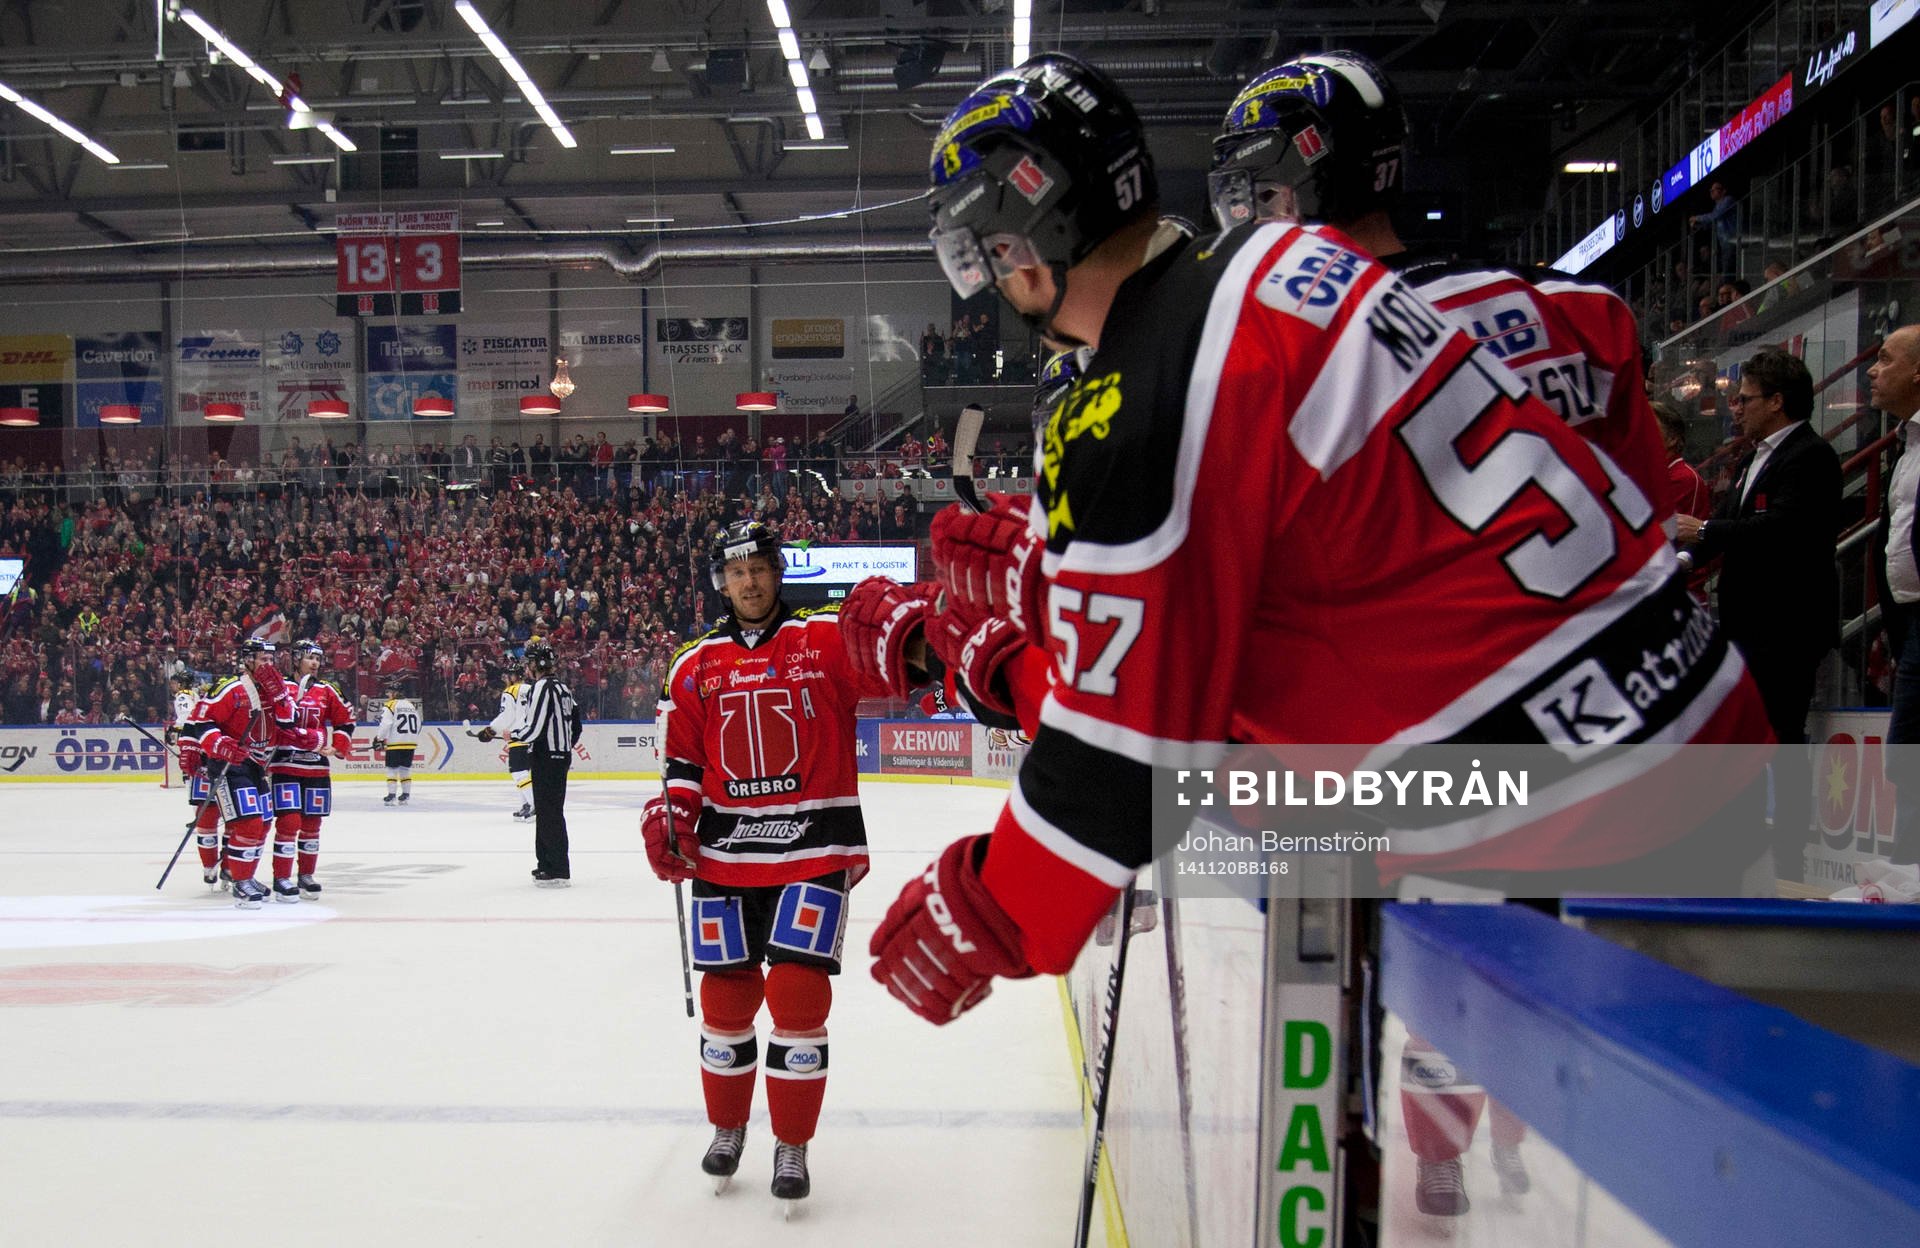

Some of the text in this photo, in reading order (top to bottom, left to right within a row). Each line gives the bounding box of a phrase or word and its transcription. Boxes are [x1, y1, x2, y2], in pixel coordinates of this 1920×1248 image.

[1236, 138, 1272, 160] EASTON
[1373, 158, 1399, 193] 37
[1114, 165, 1143, 212] 57
[344, 243, 386, 284] 13
[416, 242, 443, 283] 3
[804, 323, 841, 334] projekt
[1472, 307, 1538, 359] AB
[483, 337, 548, 349] PISCATOR
[560, 333, 642, 346] MALMBERGS
[662, 343, 710, 355] FRASSES
[775, 333, 841, 346] engagemang
[0, 351, 57, 365] DHL
[82, 349, 156, 364] Caverion
[301, 360, 352, 371] Garphyttan
[467, 374, 540, 391] mersmak
[832, 560, 908, 569] FRAKT & LOGISTIK
[1046, 582, 1145, 698] 57
[801, 687, 816, 720] A
[396, 713, 418, 734] 20
[892, 729, 960, 752] XERVON
[55, 729, 166, 772] ÖBAB
[892, 756, 927, 768] Ställningar
[933, 757, 965, 769] Väderskydd
[728, 776, 798, 798] ÖREBRO
[1813, 858, 1861, 885] VITVAR
[704, 1048, 733, 1062] MOAB
[787, 1052, 819, 1066] MOAB
